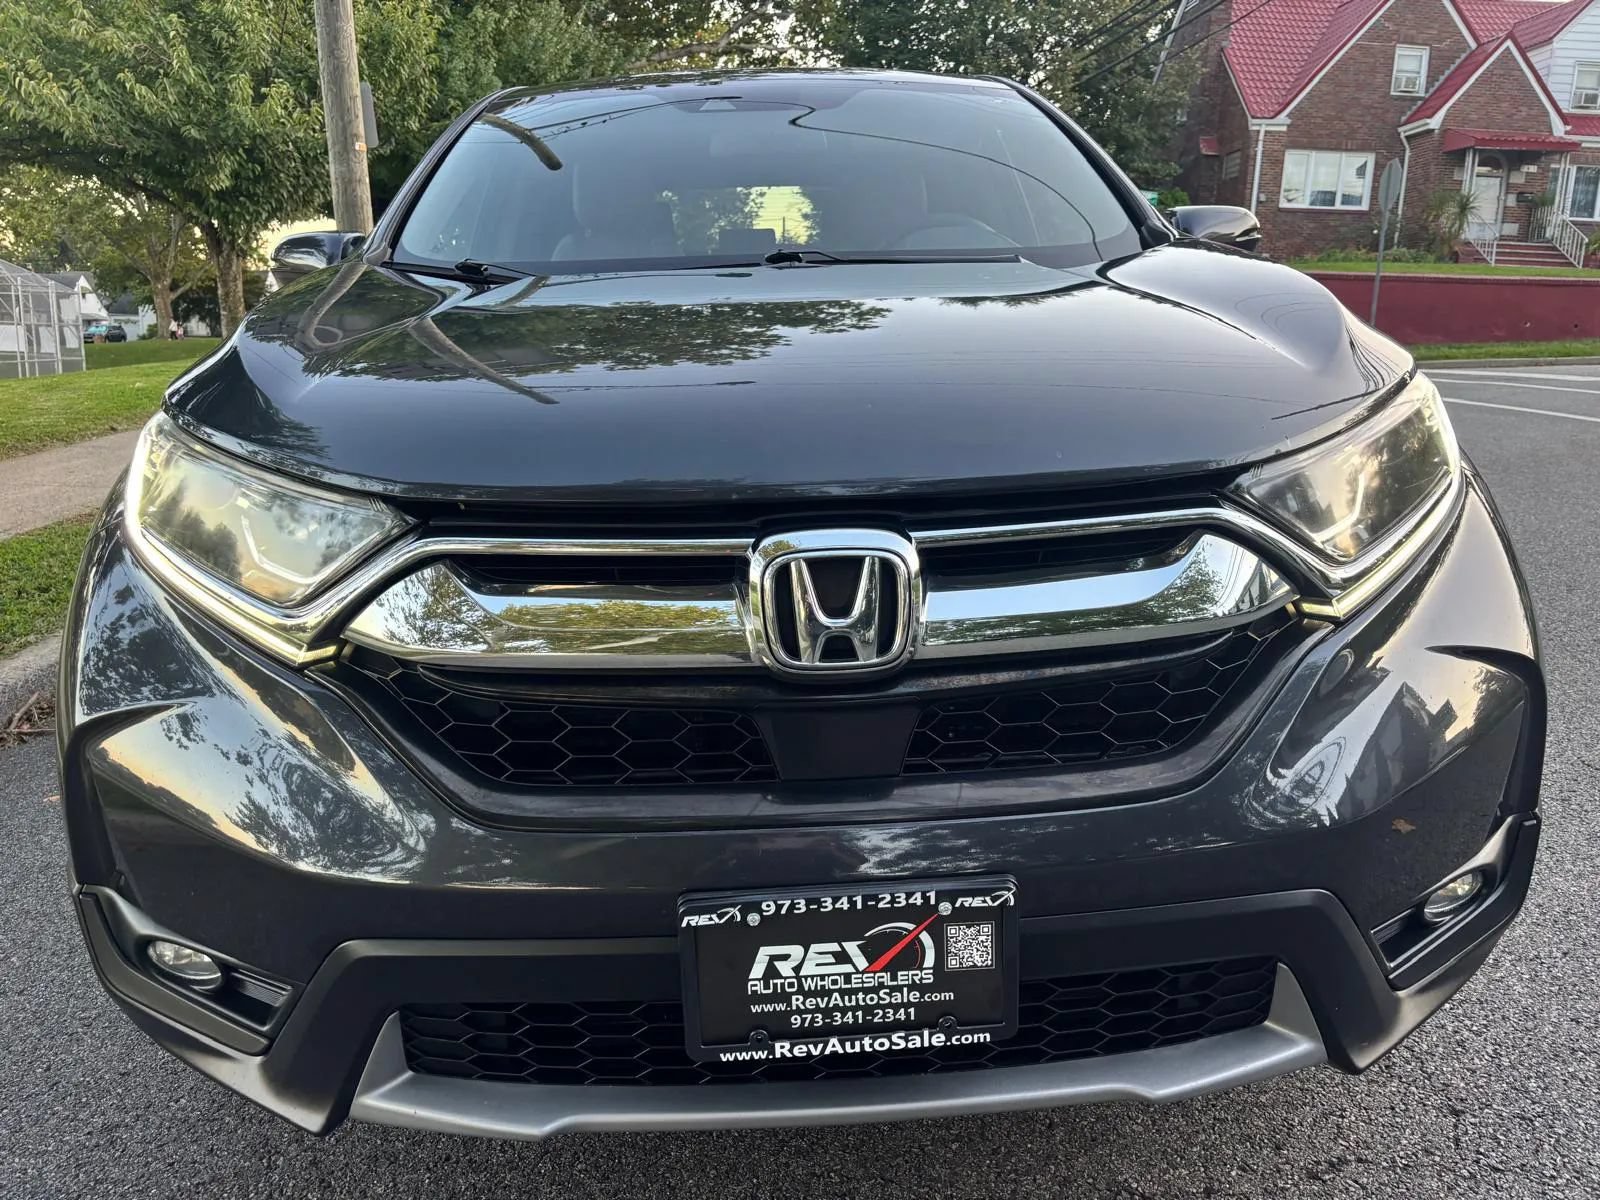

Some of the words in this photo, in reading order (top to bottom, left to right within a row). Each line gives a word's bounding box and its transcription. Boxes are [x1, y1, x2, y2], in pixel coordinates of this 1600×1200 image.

[761, 890, 936, 916] 973-341-2341
[954, 888, 1016, 908] REV
[681, 904, 742, 928] REV
[748, 913, 939, 979] REV
[747, 977, 798, 995] AUTO
[802, 969, 934, 991] WHOLESALERS
[750, 988, 955, 1013] www.RevAutoSale.com
[790, 1007, 916, 1028] 973-341-2341
[719, 1029, 991, 1062] www.RevAutoSale.com
